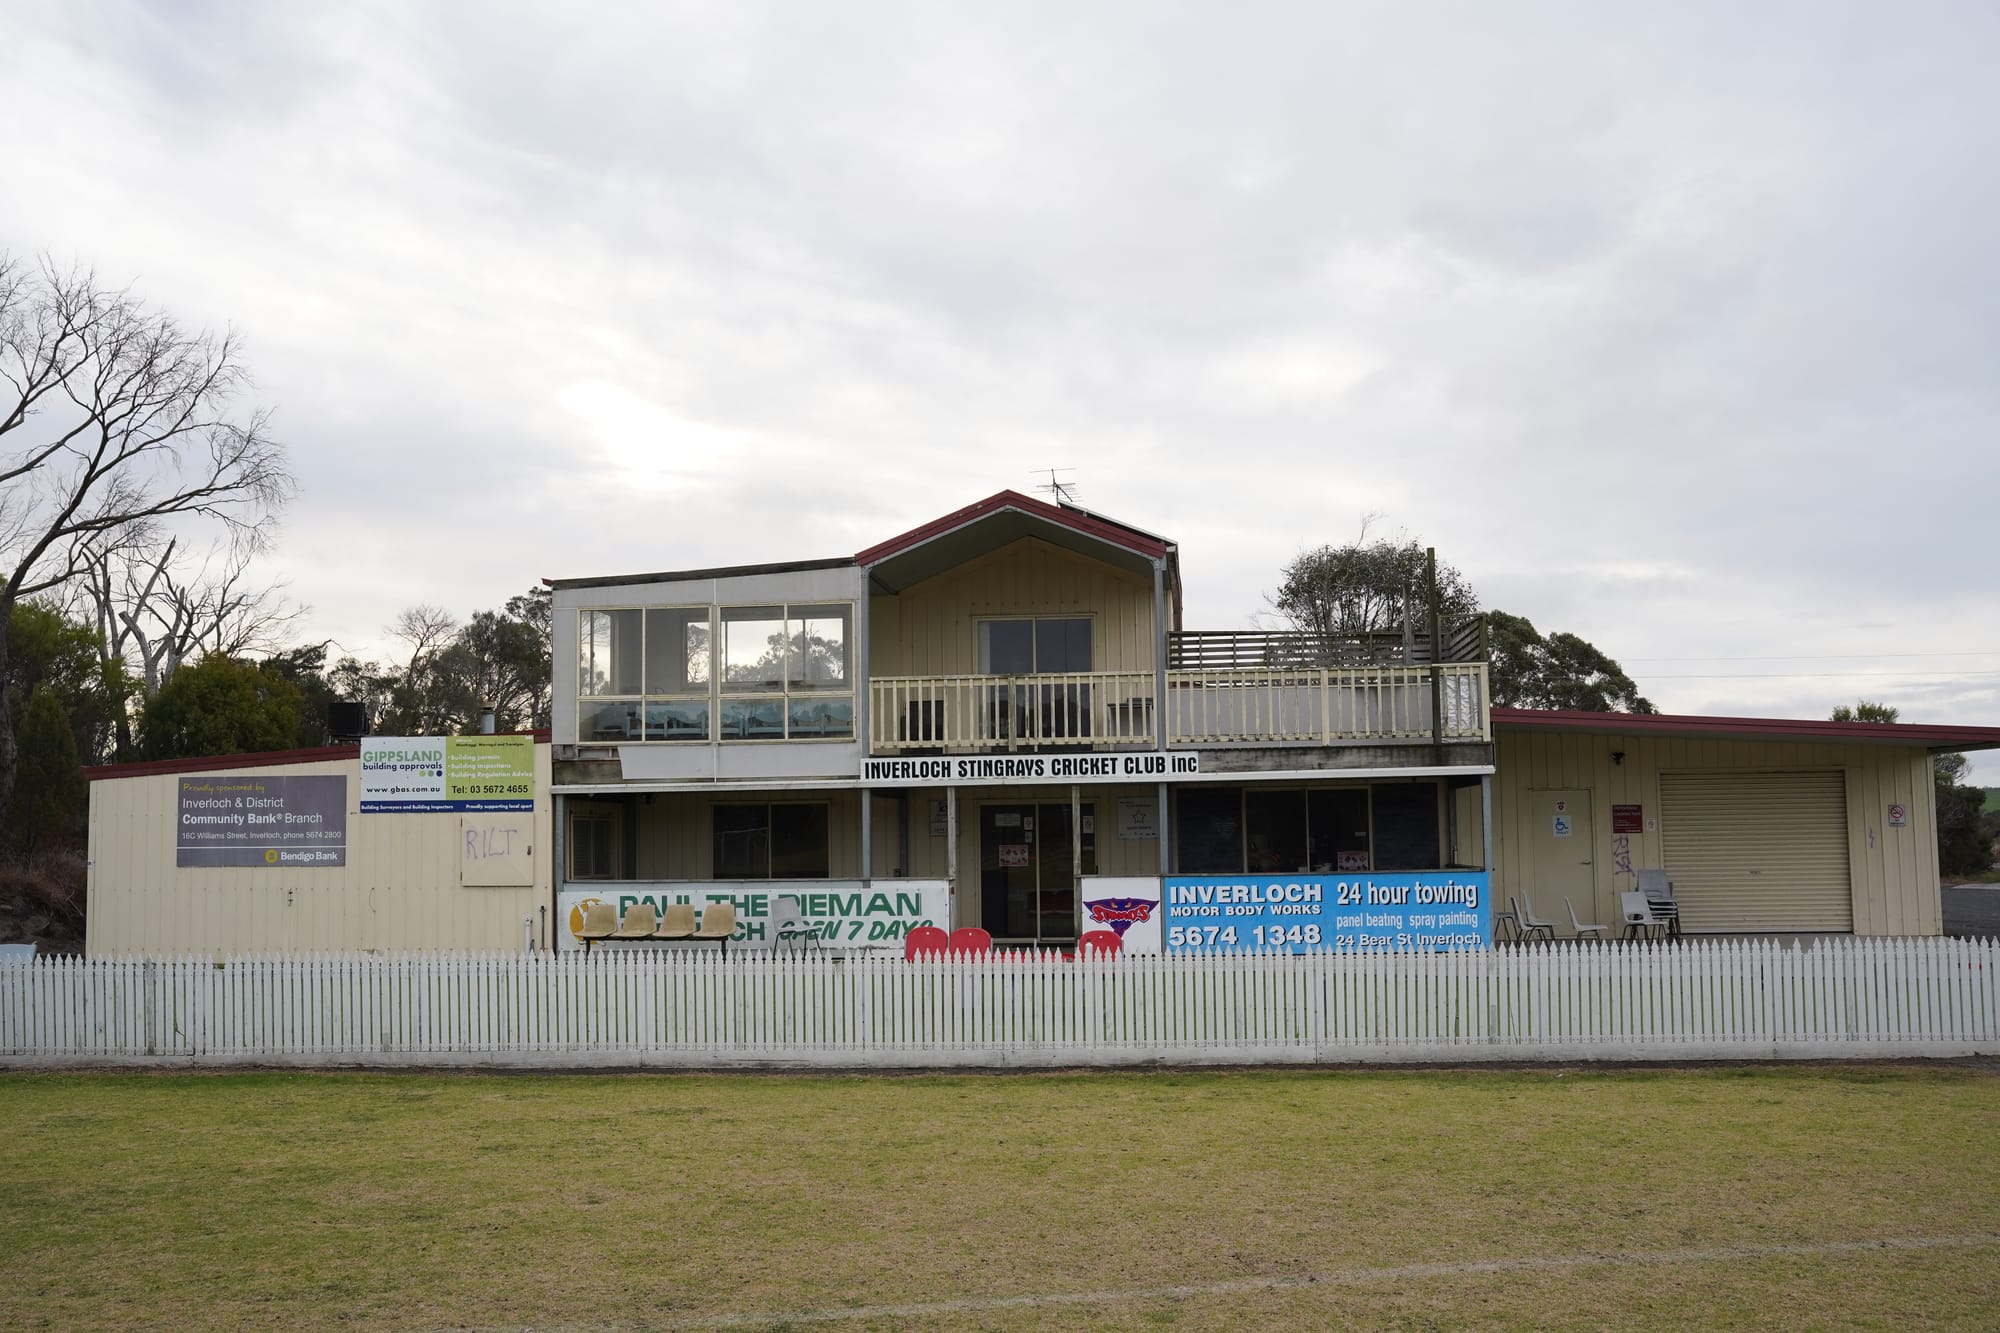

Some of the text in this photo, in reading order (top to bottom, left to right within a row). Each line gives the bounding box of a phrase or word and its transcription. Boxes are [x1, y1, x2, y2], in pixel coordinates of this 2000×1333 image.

[363, 750, 443, 762] GIPPSLAND
[363, 762, 443, 772] building approvals
[865, 755, 1197, 779] INVERLOCH STINGRAYS CRICKET CLUB inc
[183, 783, 266, 795] Proudly sponsored by
[366, 786, 441, 795] www.gbas.com.au
[452, 785, 529, 794] Tel: 03 5672 4655
[182, 797, 284, 809] Inverloch & District
[182, 813, 245, 826] Community
[284, 812, 323, 824] Branch
[182, 832, 196, 840] 16C
[197, 832, 225, 840] Williams
[283, 831, 305, 840] phone
[306, 831, 323, 839] 5674
[280, 851, 338, 862] Bendigo Bank
[1170, 884, 1323, 904] INVERLOCH
[1337, 880, 1478, 909] 24 hour towing
[706, 894, 769, 917] THE
[1170, 904, 1322, 917] MOTOR BODY WORKS
[1336, 911, 1478, 930] panel beating spray painting
[848, 919, 865, 941] 7
[1169, 924, 1322, 947] 5674 1348
[1336, 932, 1481, 947] 24 Bear St Inverloch
